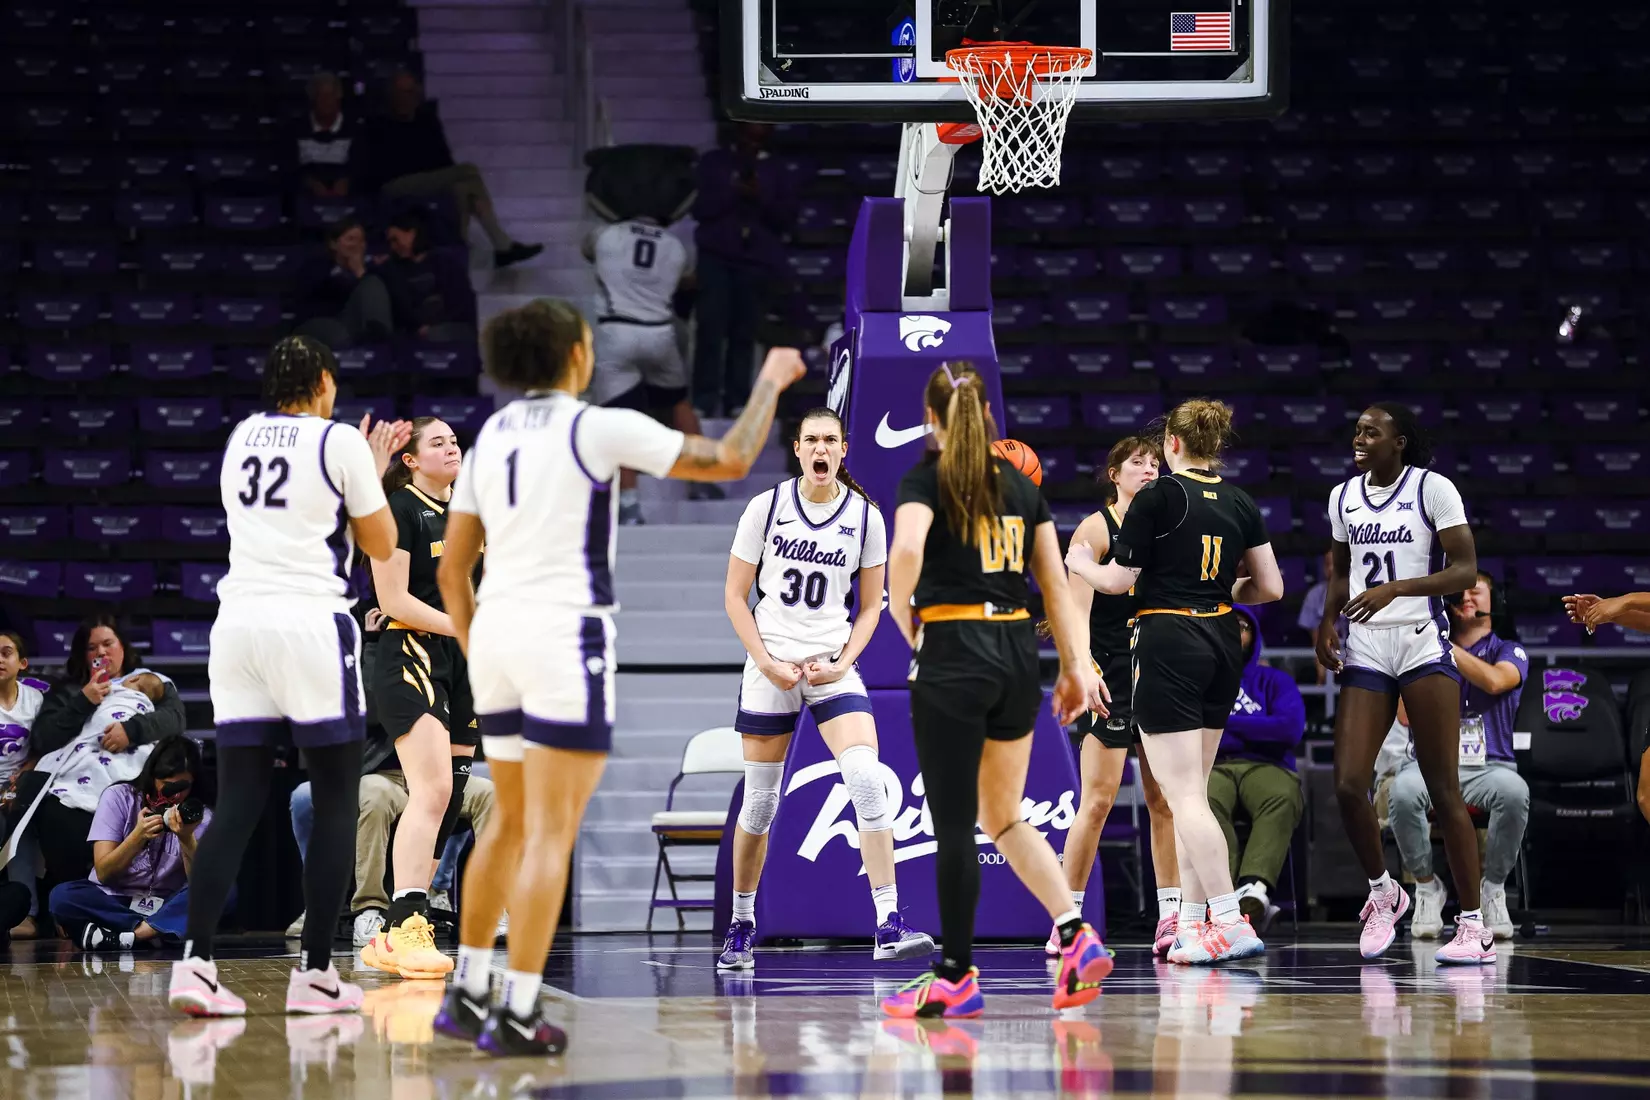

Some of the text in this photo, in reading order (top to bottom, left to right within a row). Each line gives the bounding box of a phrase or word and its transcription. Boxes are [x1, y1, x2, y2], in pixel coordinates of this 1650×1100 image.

[759, 87, 809, 99] SPALDING
[633, 238, 656, 269] 0
[244, 425, 300, 448] LESTER
[238, 455, 290, 509] 32
[504, 447, 520, 508] 1
[1348, 522, 1414, 546] Wildcats
[772, 535, 847, 568] Wildcats
[1200, 534, 1223, 581] 11
[1362, 549, 1397, 588] 21
[780, 567, 829, 611] 30
[1461, 743, 1481, 754] TV
[976, 852, 1007, 865] OOD
